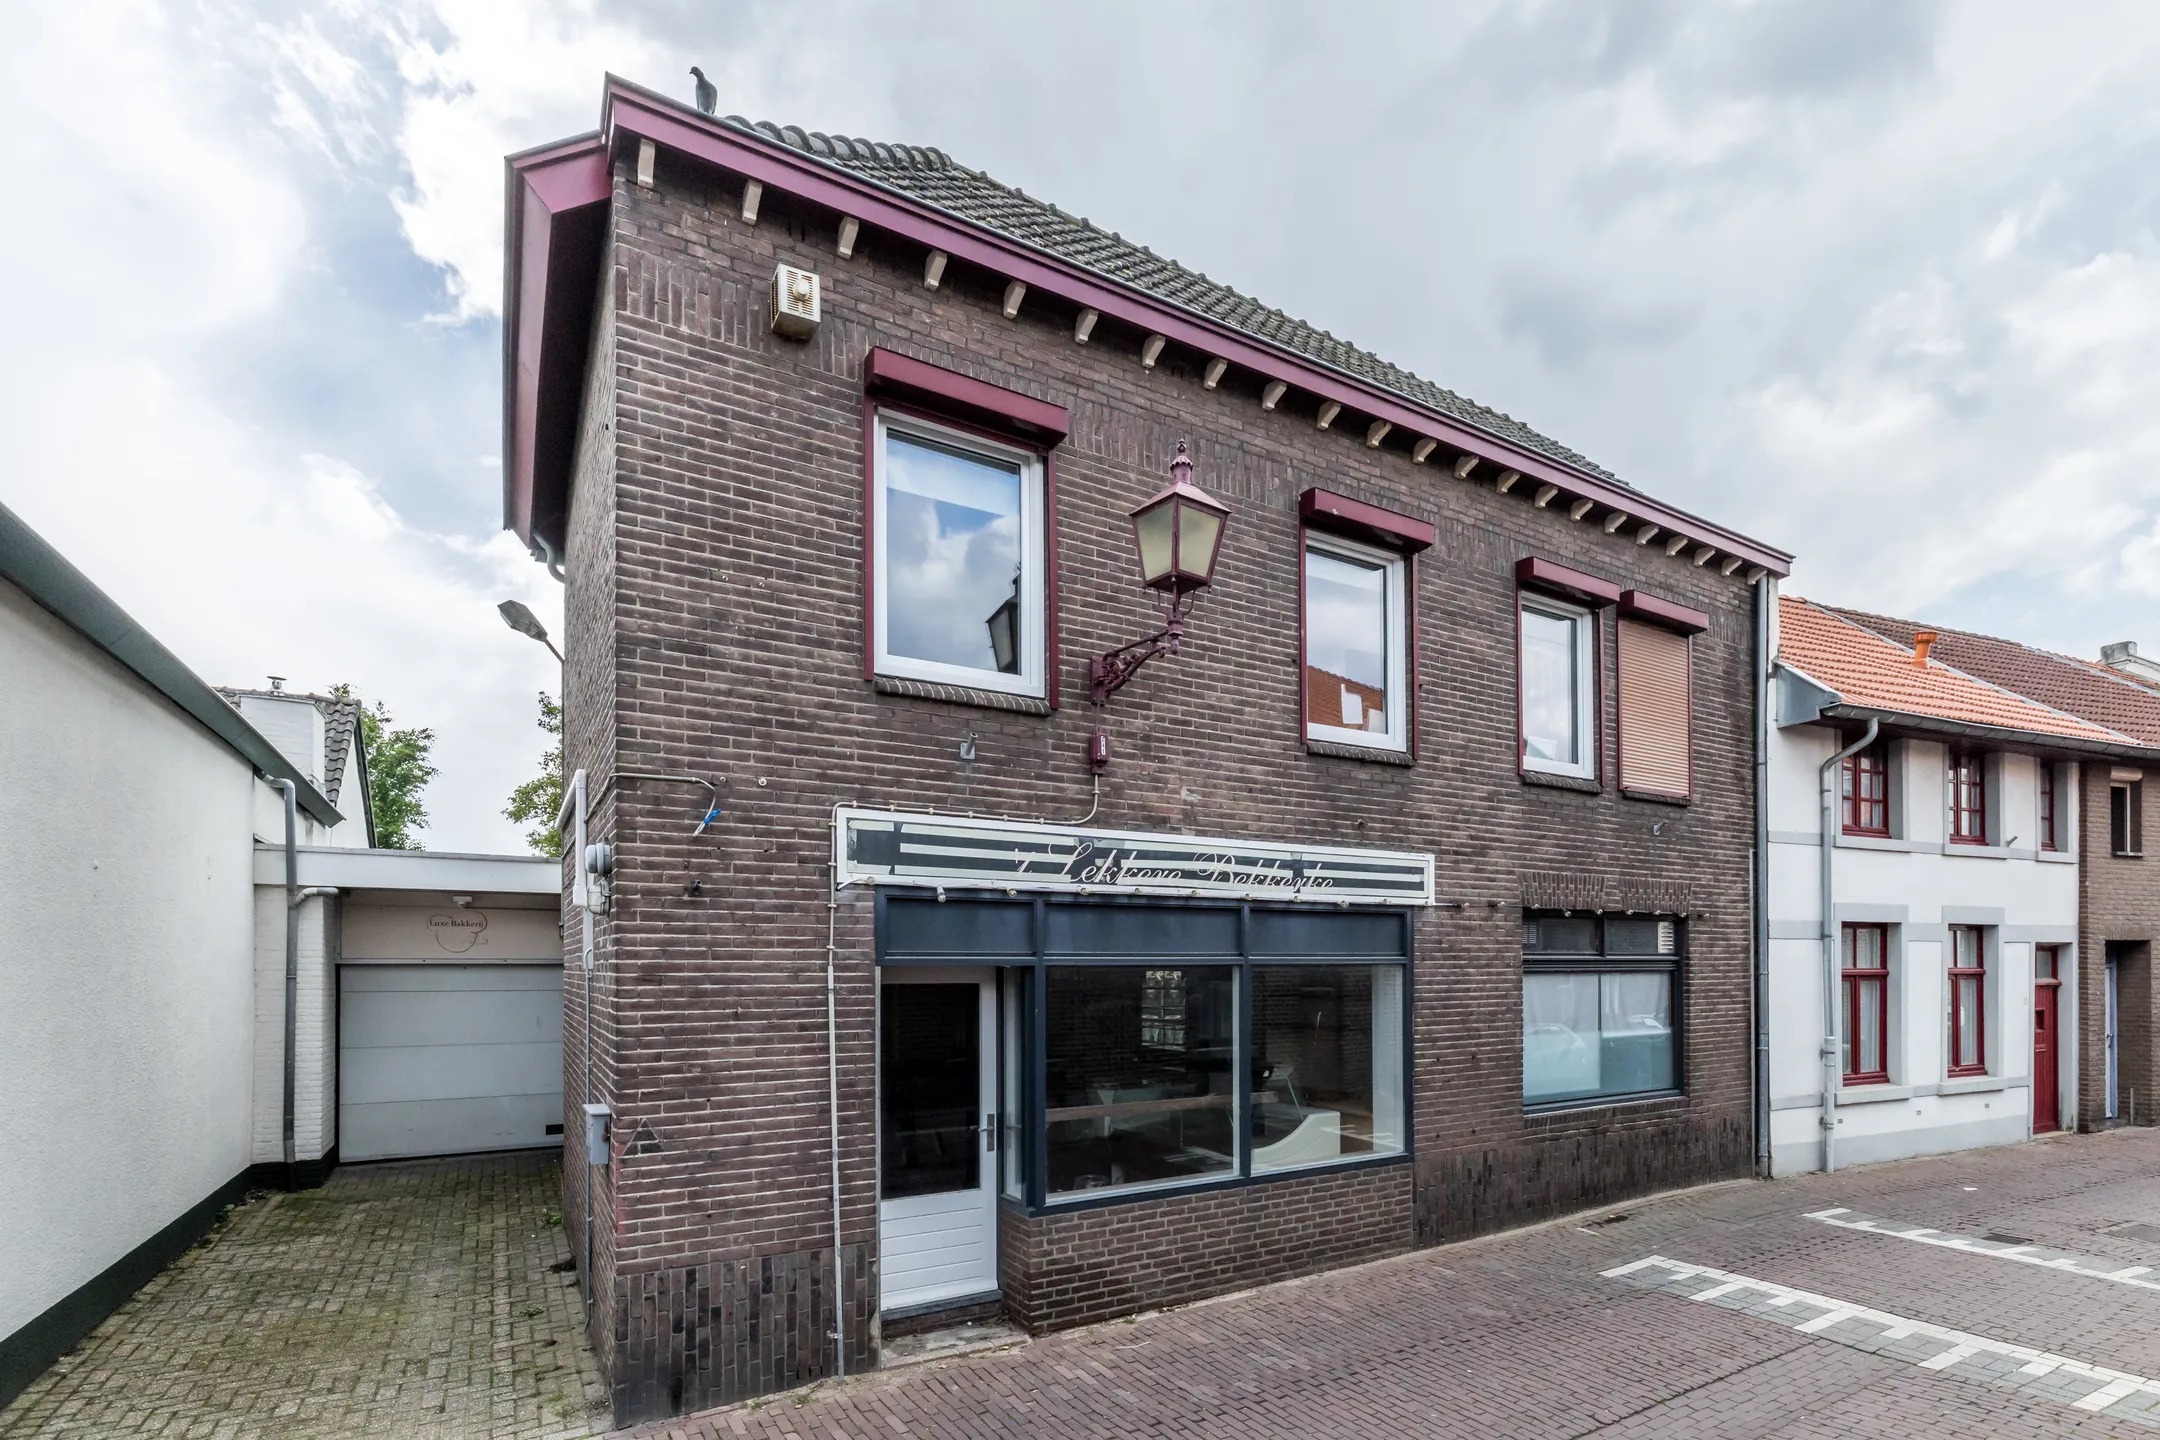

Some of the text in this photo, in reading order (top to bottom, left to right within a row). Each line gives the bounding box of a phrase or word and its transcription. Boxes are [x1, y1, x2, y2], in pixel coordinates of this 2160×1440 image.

[1048, 842, 1183, 885] Lekkere
[429, 919, 484, 928] Luxe Bakkerij
